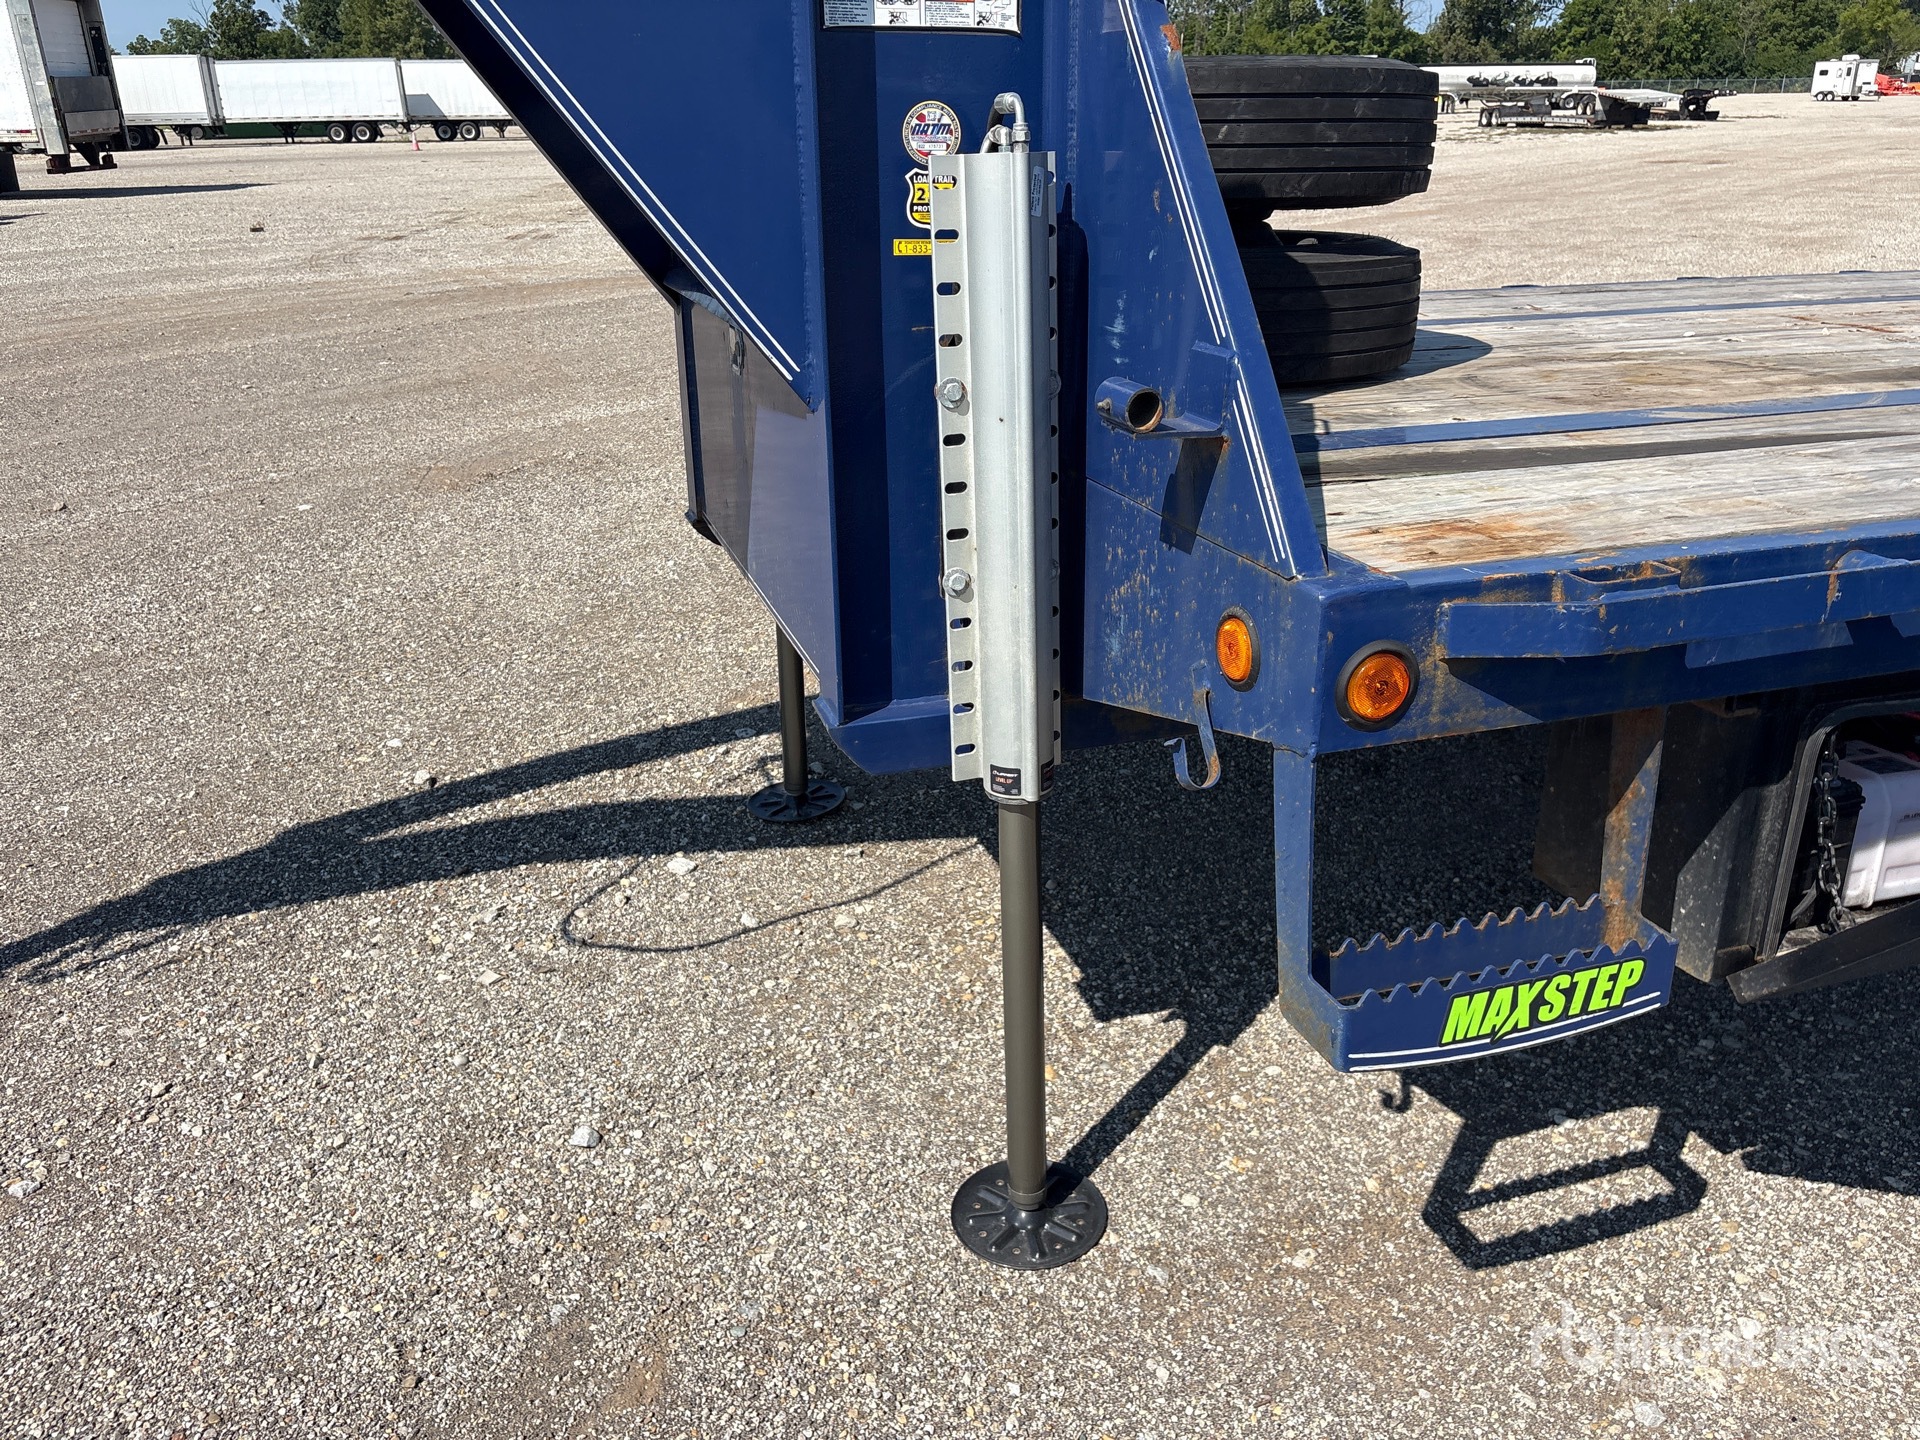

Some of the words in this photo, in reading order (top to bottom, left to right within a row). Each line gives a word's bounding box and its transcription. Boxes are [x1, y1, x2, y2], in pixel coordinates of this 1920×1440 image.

[911, 103, 942, 116] COMPLIANCE
[911, 123, 952, 135] NATM
[934, 175, 954, 183] TRAIL
[1441, 959, 1645, 1043] MAXSTEP
